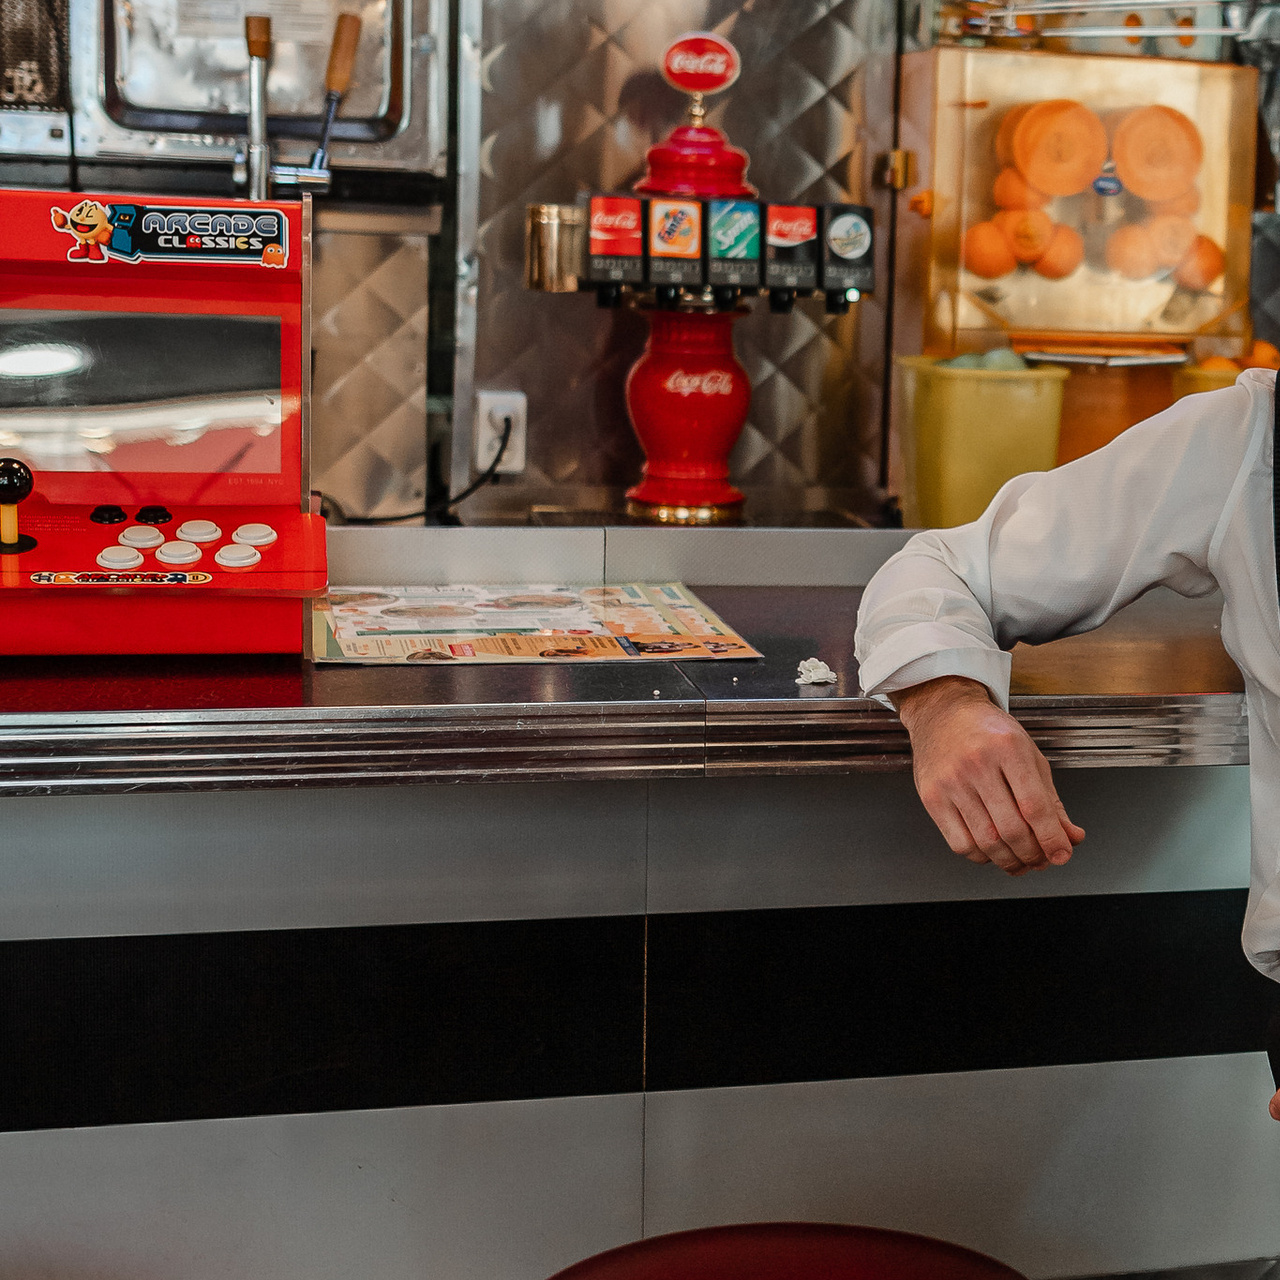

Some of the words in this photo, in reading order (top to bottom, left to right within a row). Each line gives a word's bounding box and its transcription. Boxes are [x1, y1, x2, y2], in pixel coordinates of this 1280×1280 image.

[671, 51, 727, 75] Coca-Cola
[142, 212, 278, 236] ARCADE
[593, 211, 638, 230] Coca-Cola
[665, 369, 733, 396] Coca-Cola
